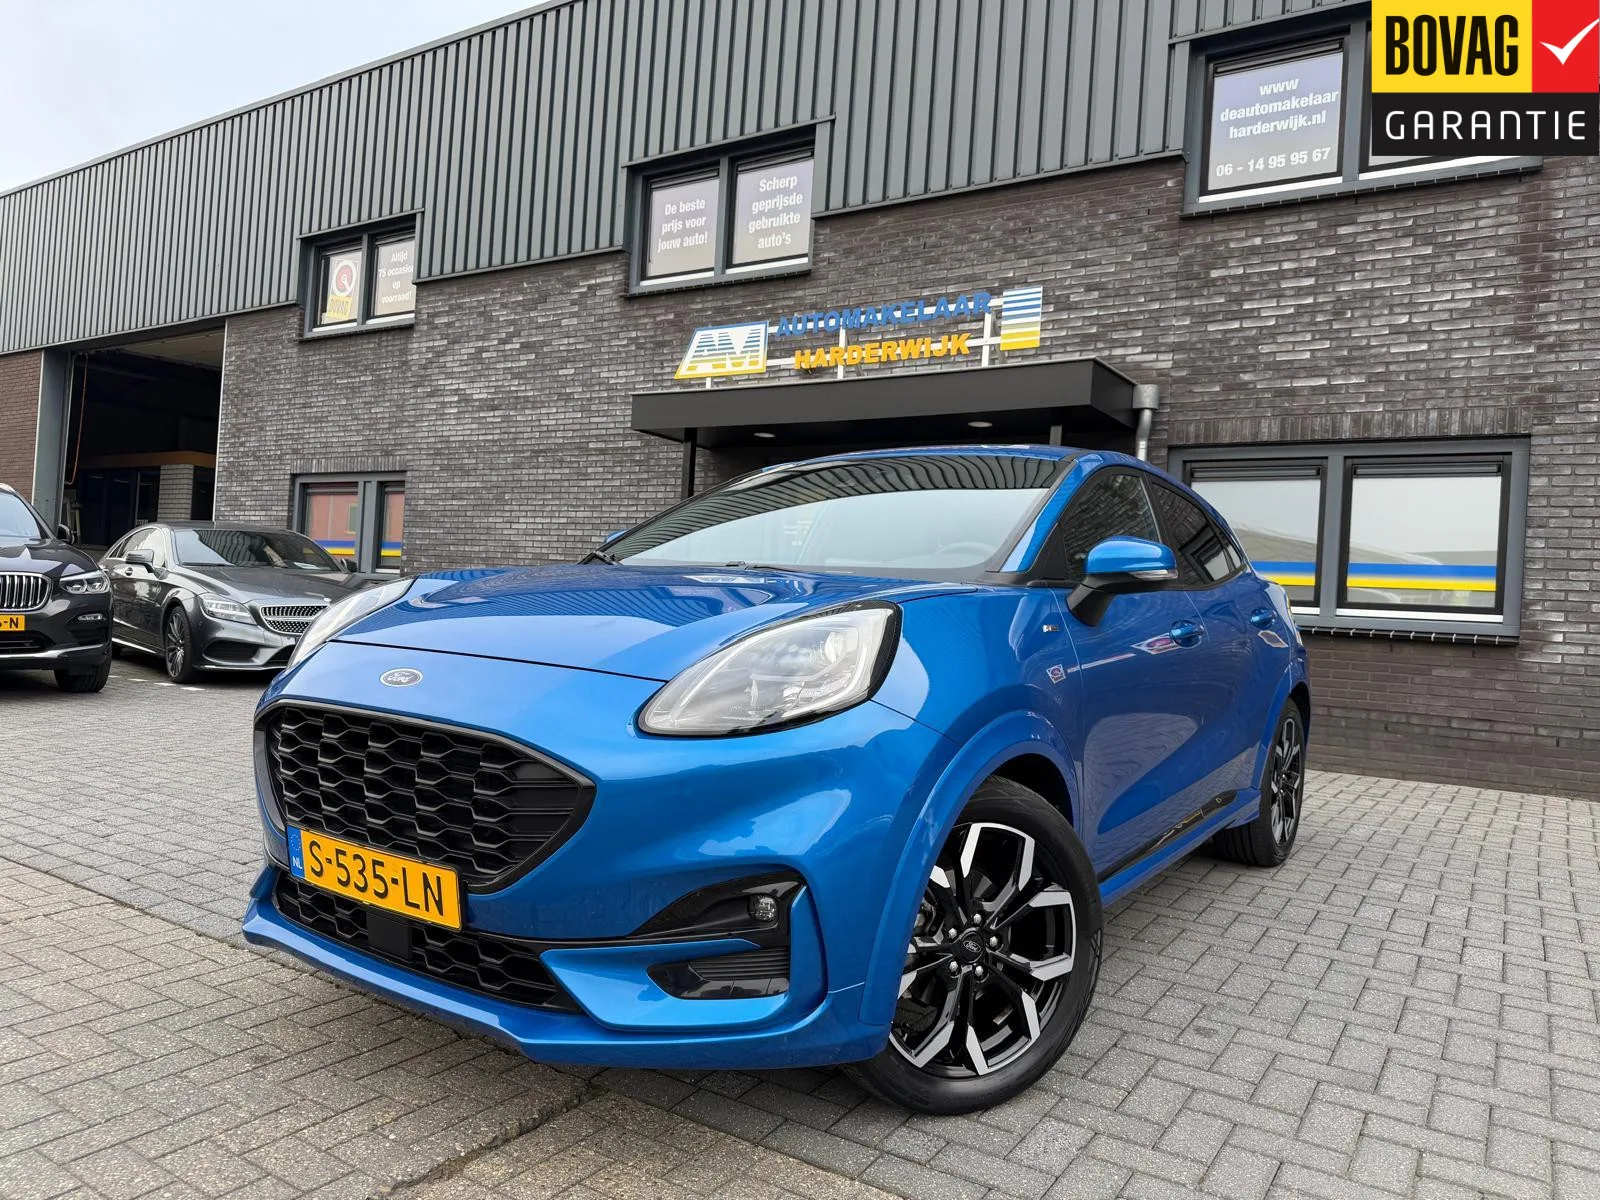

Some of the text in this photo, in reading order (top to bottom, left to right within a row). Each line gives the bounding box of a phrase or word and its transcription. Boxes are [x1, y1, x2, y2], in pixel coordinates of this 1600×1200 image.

[1259, 78, 1299, 96] www
[1220, 90, 1339, 122] deautomakelaar
[1228, 110, 1327, 139] harderwijk.nl
[1215, 163, 1233, 177] 06
[1247, 158, 1264, 172] 14
[1268, 154, 1286, 169] 95
[1290, 151, 1308, 165] 95
[1312, 147, 1331, 162] 67
[759, 175, 797, 192] Scherp
[665, 198, 706, 216] De beste
[752, 192, 804, 215] geprijsde
[661, 215, 707, 236] prijs voor
[748, 212, 801, 234] gebruikte
[657, 231, 709, 254] jouw auto!
[757, 232, 792, 249] auto's
[392, 280, 401, 290] op
[776, 291, 992, 337] AUTOMAKELAAR
[794, 332, 971, 370] HARDERWIJK
[292, 856, 303, 871] NL
[308, 840, 444, 917] S-535-LN
